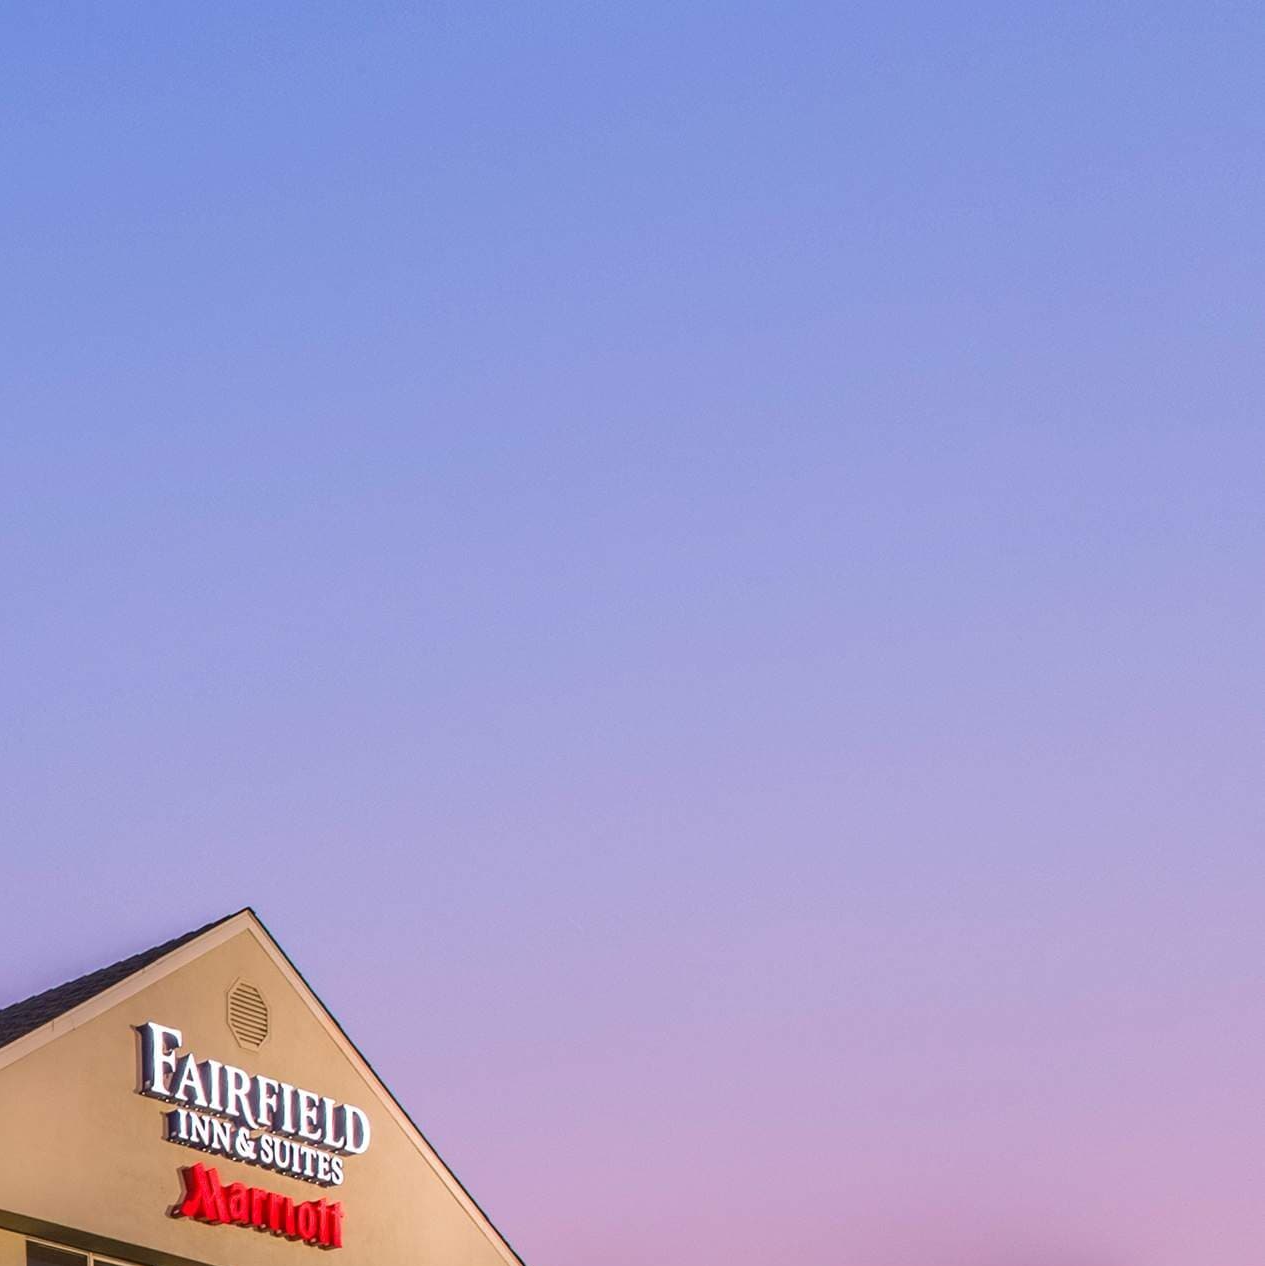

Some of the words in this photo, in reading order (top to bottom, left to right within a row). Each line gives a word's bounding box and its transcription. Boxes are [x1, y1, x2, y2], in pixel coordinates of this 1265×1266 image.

[140, 1021, 371, 1155] FAIRFIELD
[170, 1108, 232, 1153] INN
[236, 1127, 257, 1161] &
[260, 1134, 344, 1187] SUITES
[180, 1162, 344, 1249] Marriott
